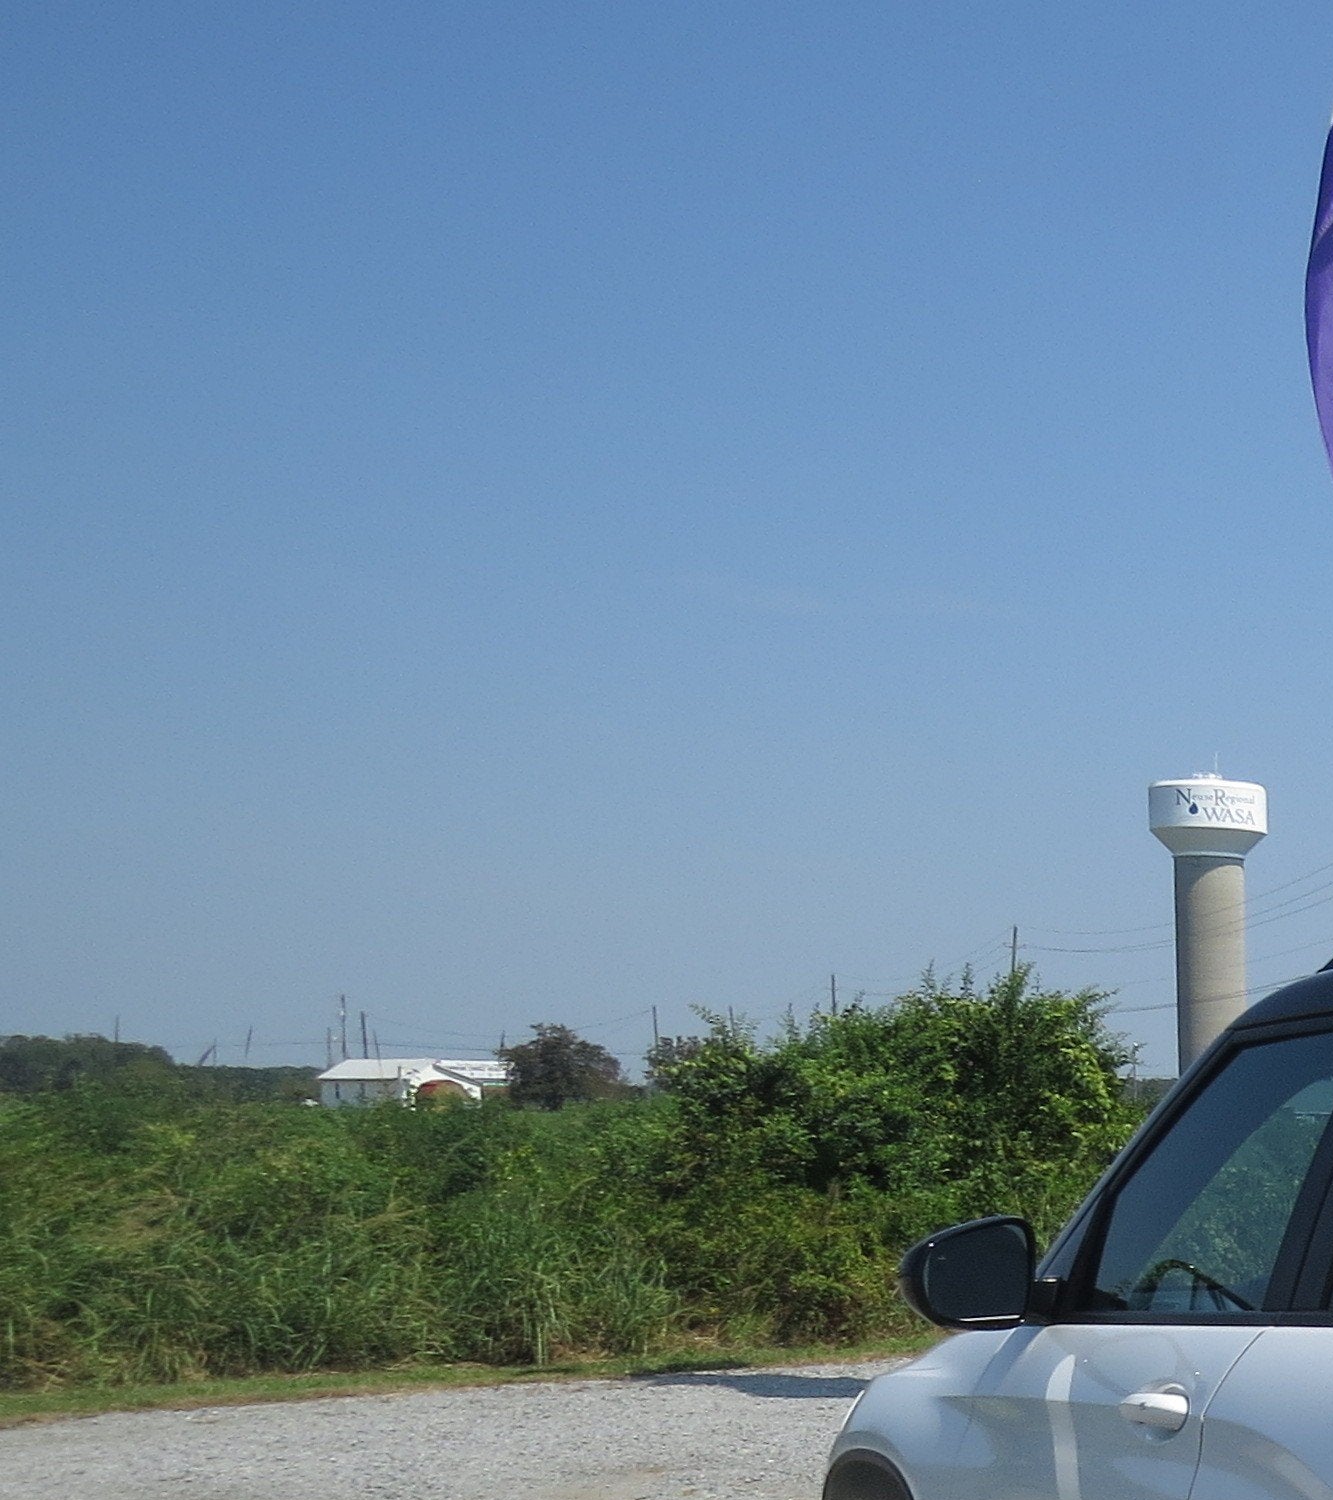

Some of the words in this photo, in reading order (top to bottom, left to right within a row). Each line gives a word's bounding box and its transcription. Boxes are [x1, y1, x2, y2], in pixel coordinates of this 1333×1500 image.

[1175, 788, 1214, 806] Neuse
[1214, 788, 1255, 807] Regional
[1203, 807, 1256, 825] WASA
